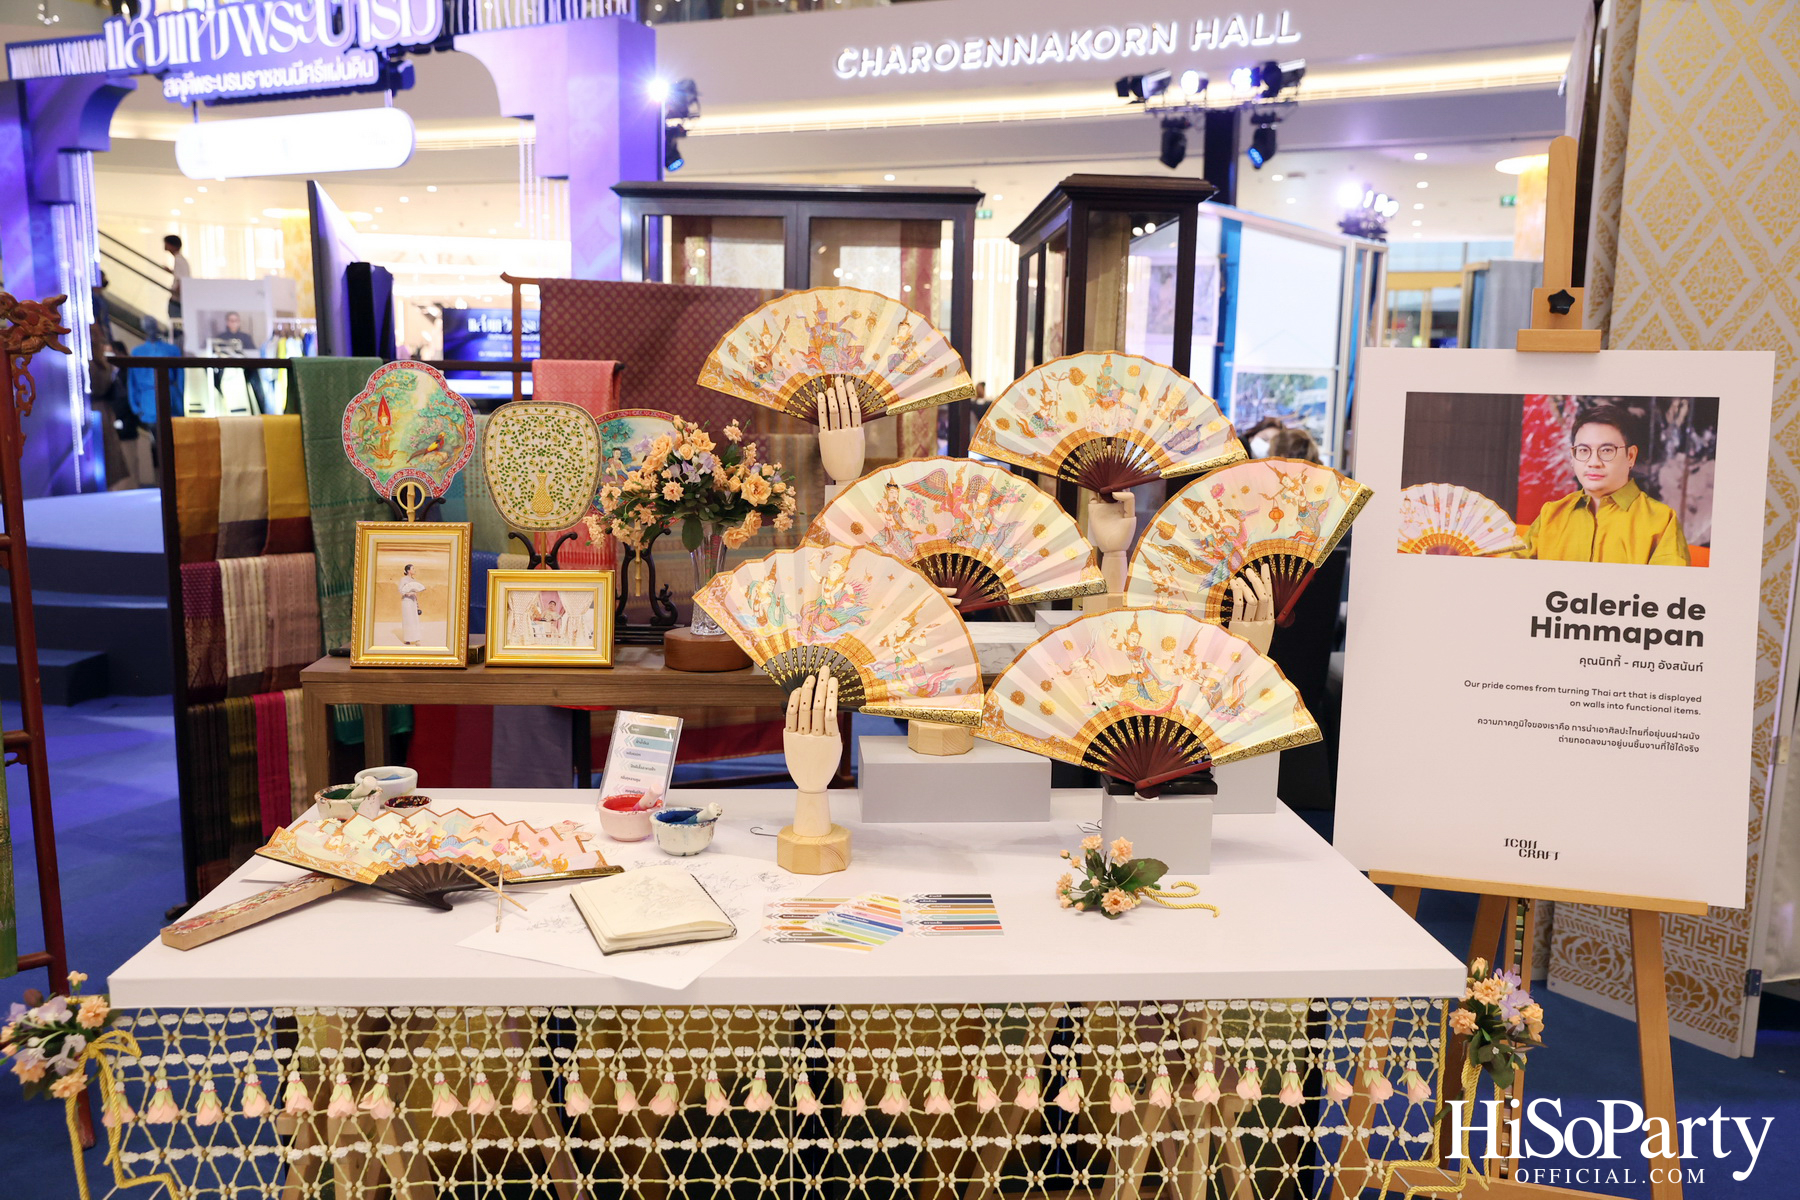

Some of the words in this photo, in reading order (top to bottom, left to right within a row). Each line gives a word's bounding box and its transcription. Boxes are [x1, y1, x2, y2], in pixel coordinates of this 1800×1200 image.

[834, 21, 1178, 80] CHAROENNAKORN
[1190, 10, 1301, 52] HALL
[1545, 590, 1659, 618] Galerie
[1666, 596, 1706, 621] de
[1530, 615, 1704, 651] Himmapan
[1579, 653, 1622, 668] คุณนิกกี้
[1631, 659, 1655, 673] ศมภู
[1657, 658, 1704, 673] อังสนันท์
[1463, 679, 1480, 688] Our
[1481, 681, 1504, 690] pride
[1505, 683, 1534, 692] comes
[1535, 684, 1556, 693] from
[1558, 686, 1590, 697] turning
[1592, 688, 1612, 697] Thai
[1612, 690, 1627, 698] art
[1628, 691, 1647, 699] that
[1649, 692, 1657, 700] is
[1658, 693, 1702, 704] displayed
[1583, 701, 1605, 709] walls
[1606, 702, 1624, 710] into
[1626, 703, 1672, 714] functional
[1673, 706, 1702, 716] items.
[1503, 837, 1538, 850] ICON
[1518, 848, 1560, 861] CRAFT
